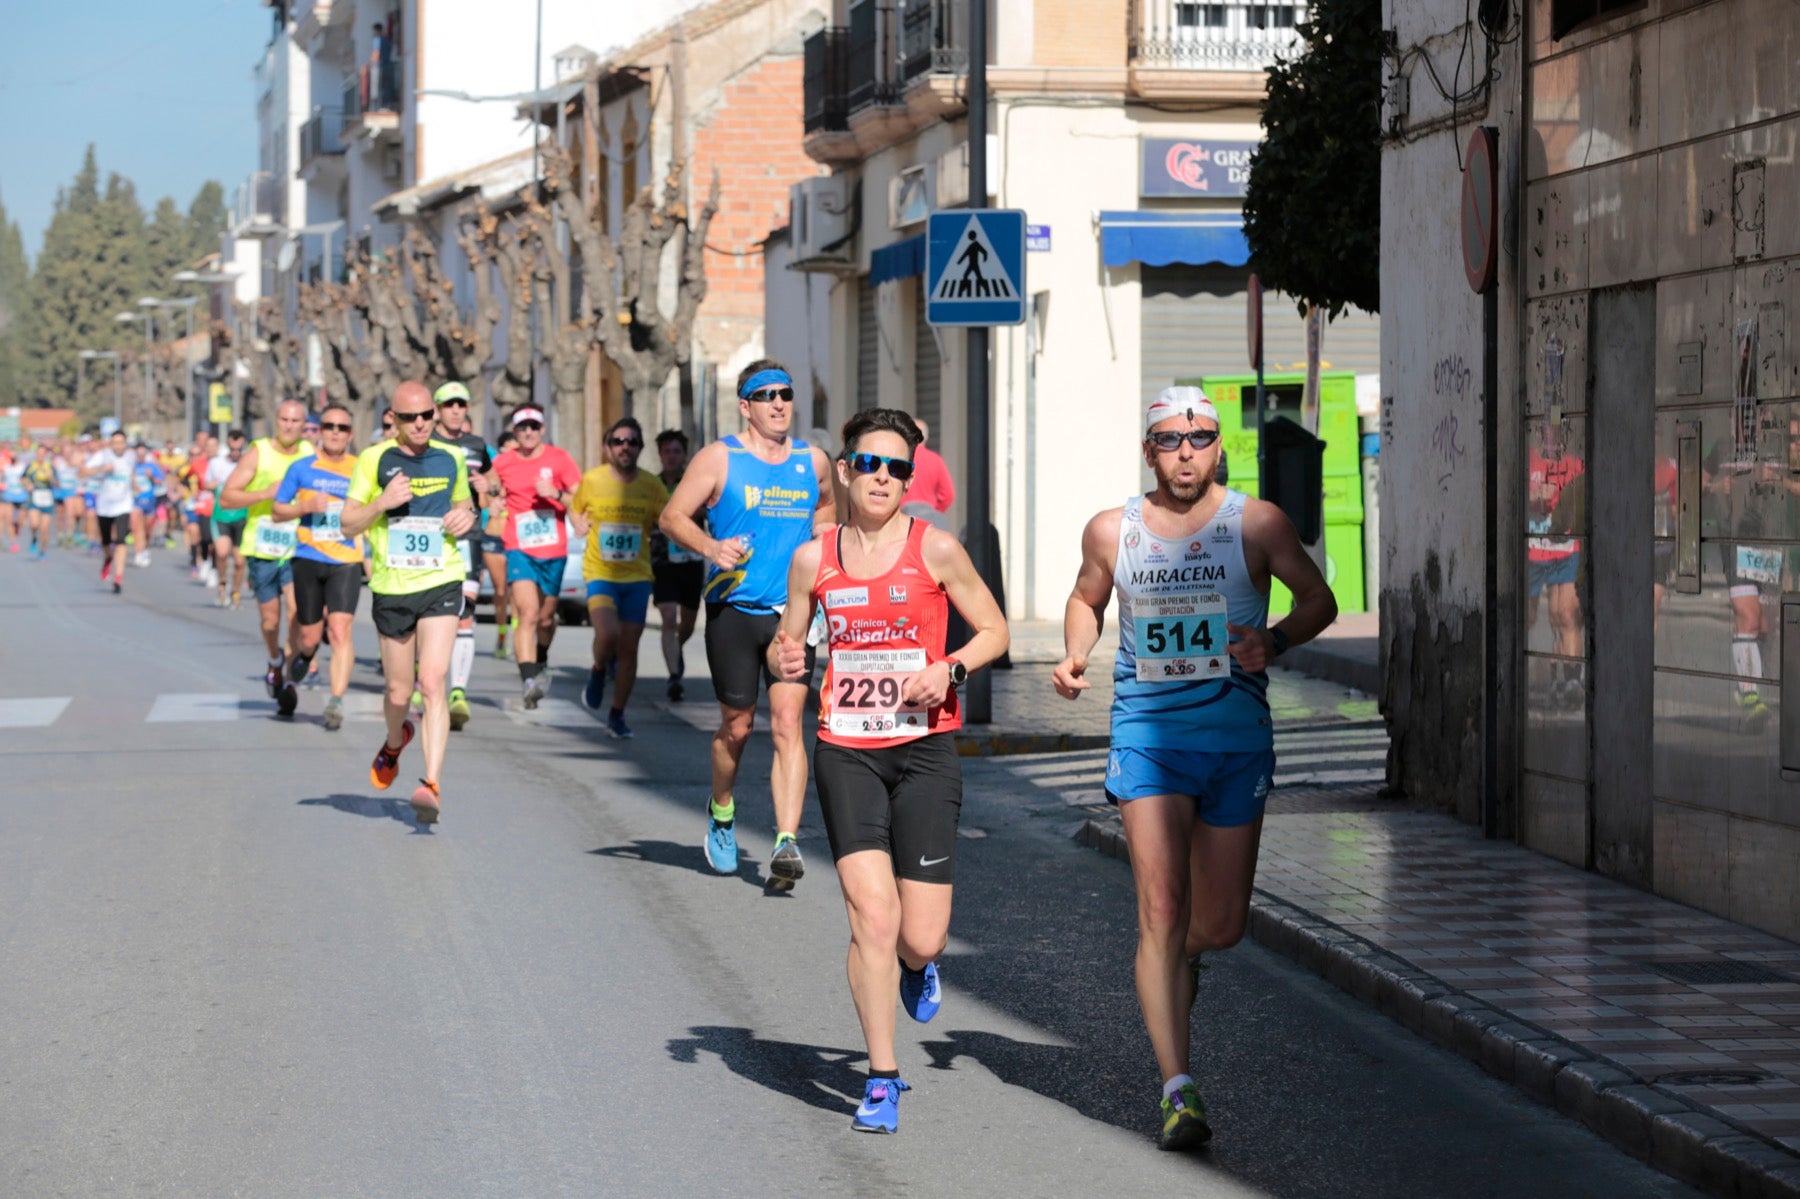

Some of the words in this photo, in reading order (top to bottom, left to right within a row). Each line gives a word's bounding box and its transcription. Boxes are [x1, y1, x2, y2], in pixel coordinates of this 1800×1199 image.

[1213, 150, 1258, 167] GRA
[764, 486, 809, 502] olimpo
[319, 514, 339, 528] 48
[262, 529, 291, 546] 888
[405, 533, 430, 553] 39
[605, 534, 634, 549] 491
[1131, 564, 1226, 586] MARACENA
[1151, 597, 1167, 606] GRAN
[1168, 596, 1189, 605] PREMIO
[1191, 596, 1199, 604] DE
[1200, 594, 1220, 603] FONDO
[1160, 605, 1195, 616] DIPUTACIÓN
[828, 614, 919, 645] Polisalud
[851, 618, 887, 629] Clínicas
[1147, 619, 1213, 653] 514
[853, 653, 868, 661] GRAN
[869, 652, 890, 661] PREMIO
[891, 652, 898, 660] DE
[900, 651, 919, 660] FONDO
[860, 662, 895, 671] DIPUTACIÓN
